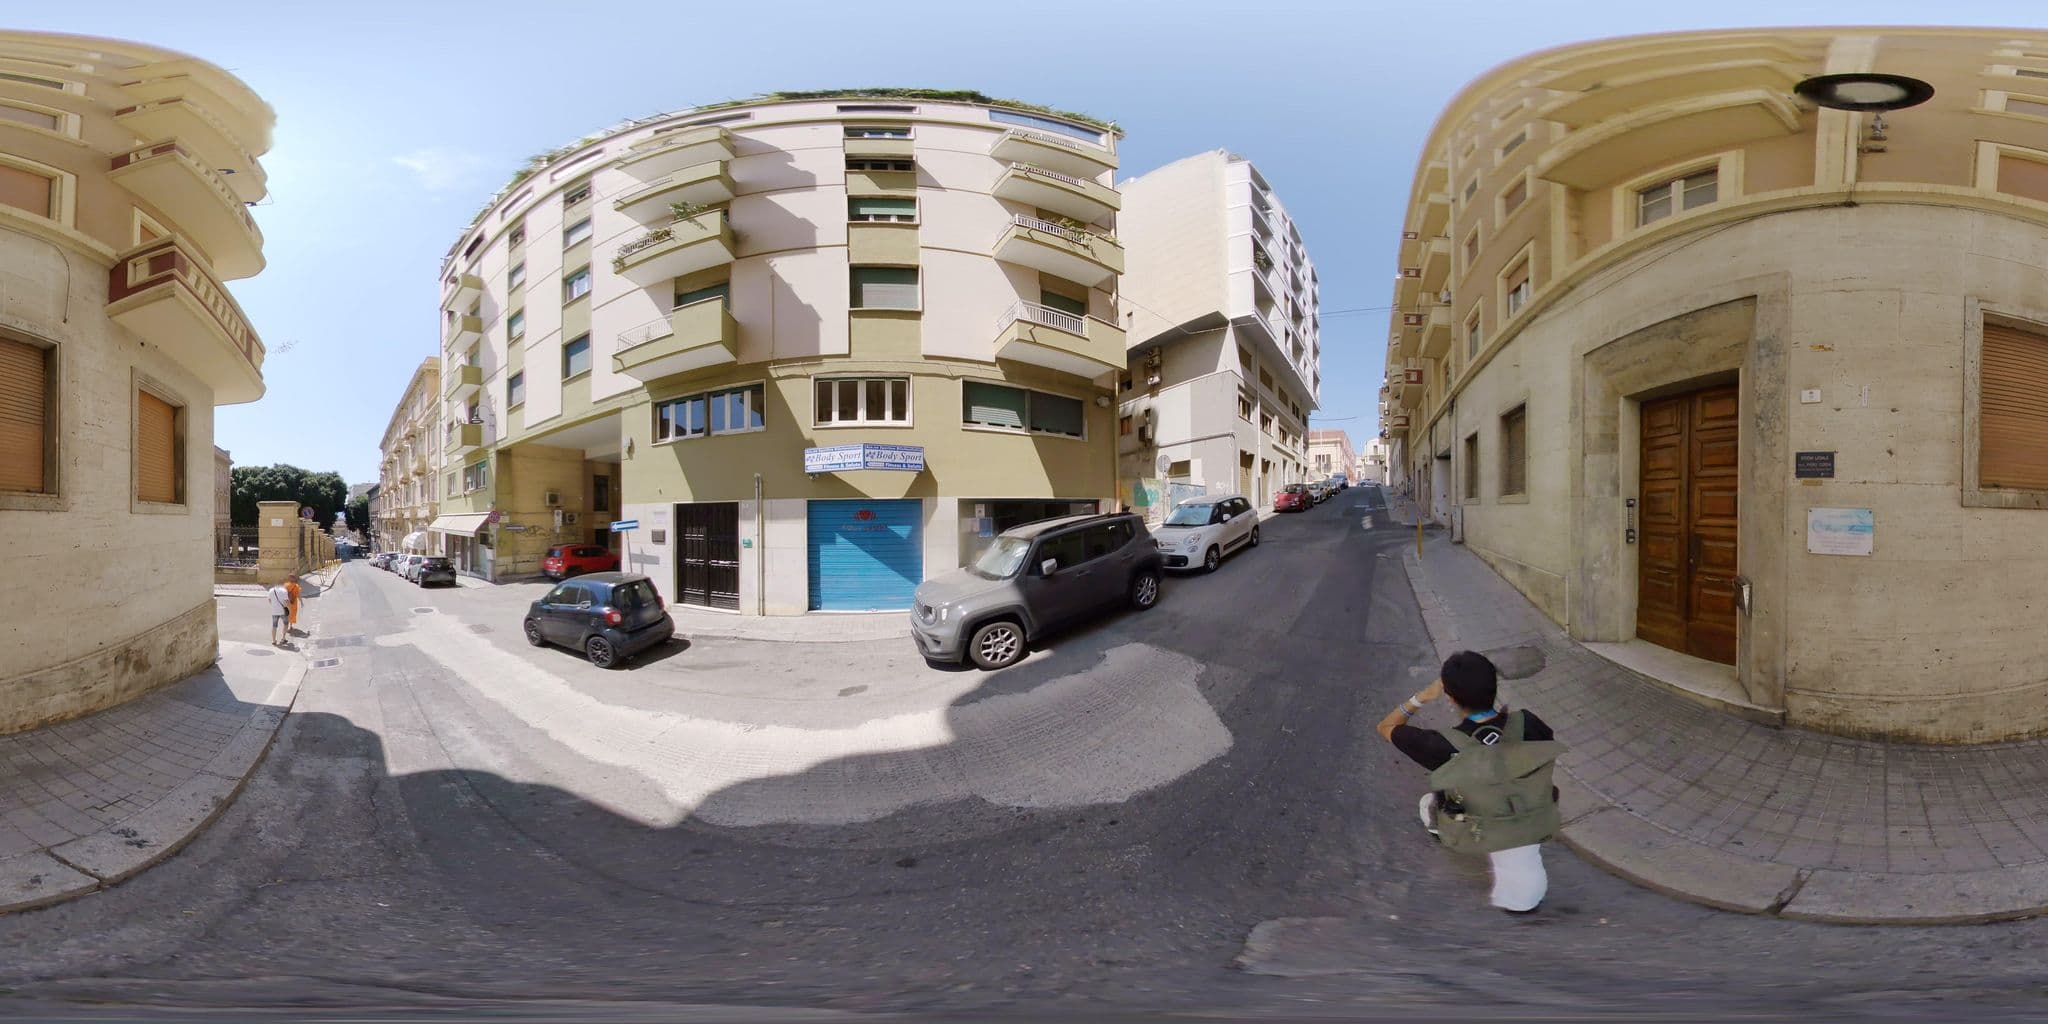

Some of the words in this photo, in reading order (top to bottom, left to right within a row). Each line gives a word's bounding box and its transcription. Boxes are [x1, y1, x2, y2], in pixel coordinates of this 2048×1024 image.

[816, 453, 834, 463] Body
[838, 451, 861, 461] Sport
[877, 451, 898, 461] Body
[900, 452, 922, 462] Sport
